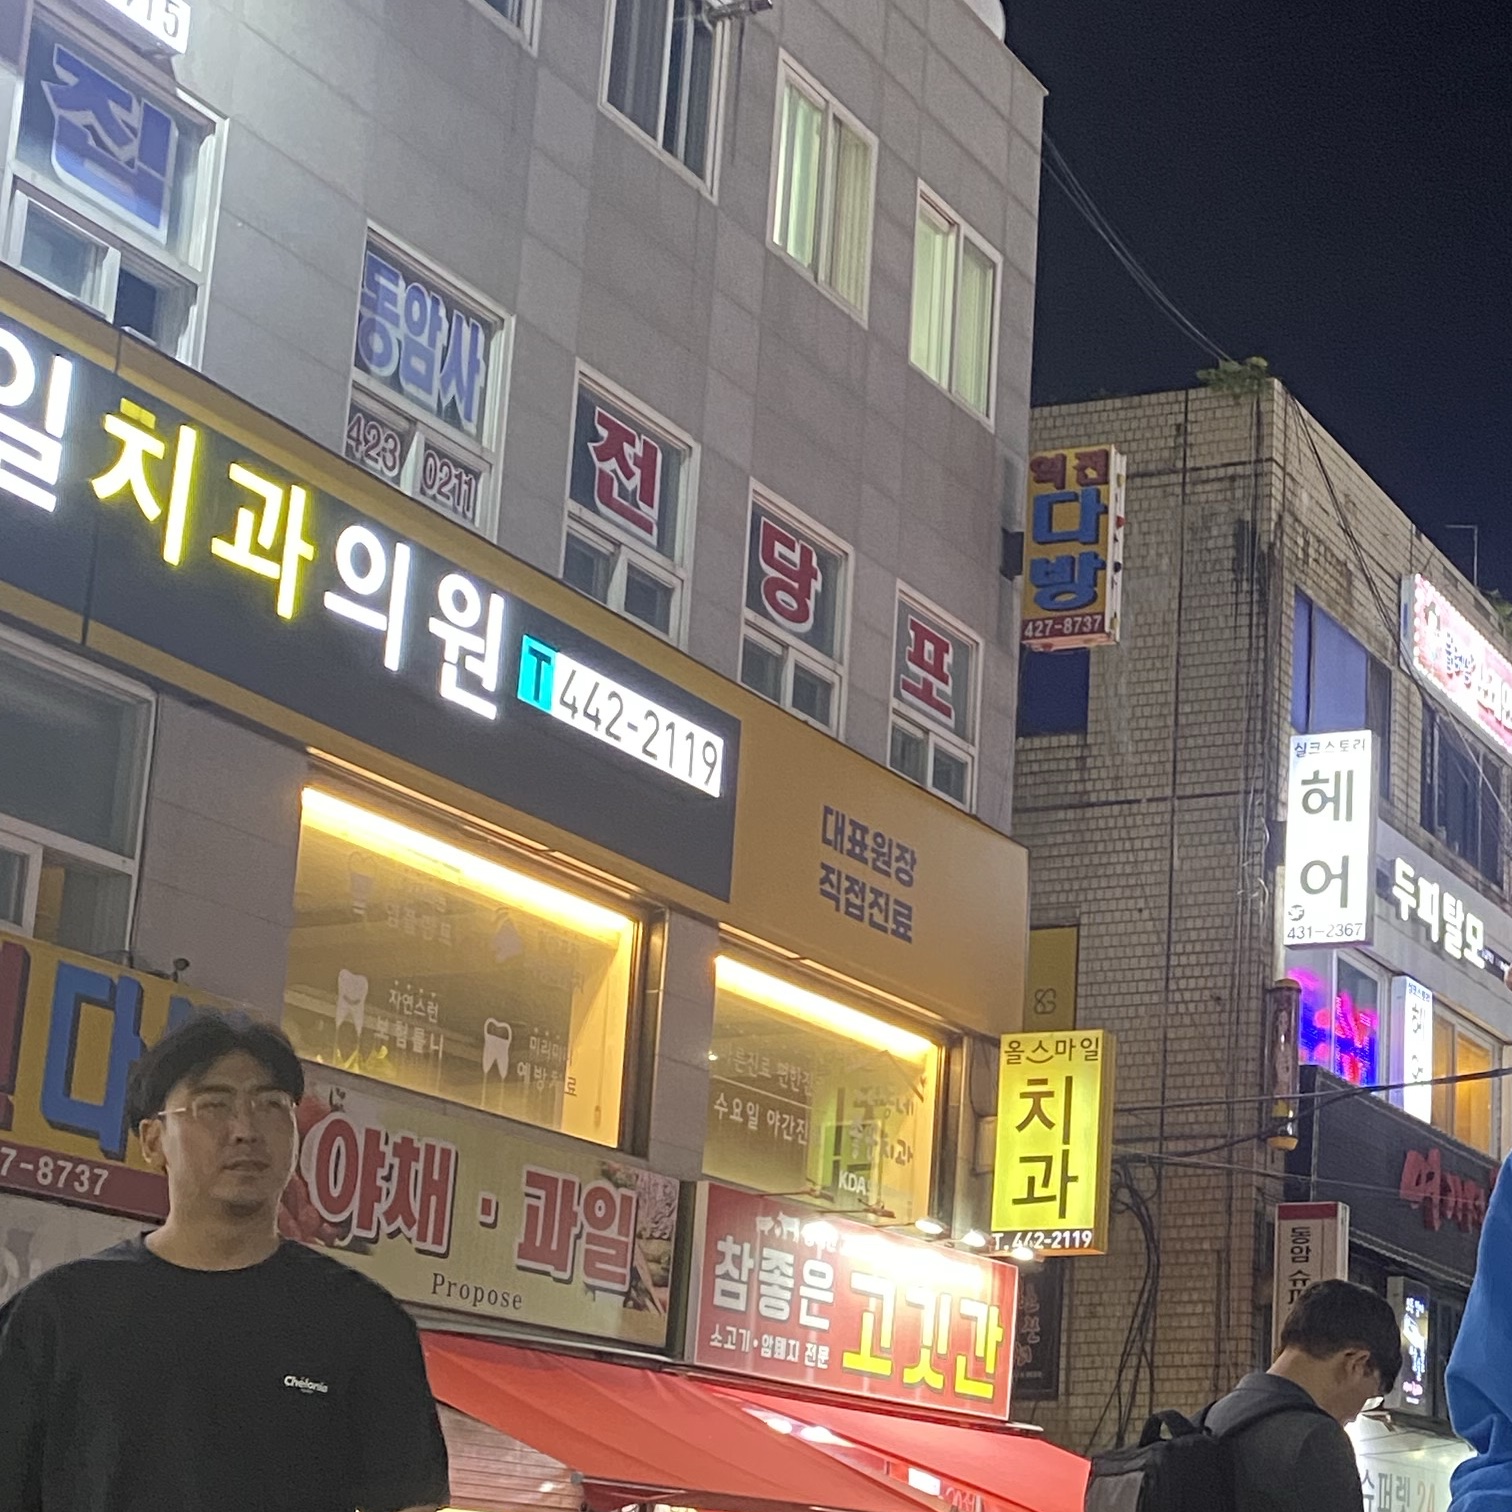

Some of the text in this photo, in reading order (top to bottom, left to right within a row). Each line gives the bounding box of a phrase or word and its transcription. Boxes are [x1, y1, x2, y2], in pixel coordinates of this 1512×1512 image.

[357, 250, 487, 436] 동암사
[346, 411, 478, 518] 423 0211
[1029, 486, 1109, 613] 다방
[1024, 615, 1103, 640] 427-8737
[527, 644, 719, 787] T 442-2119
[1294, 738, 1366, 758] 실크스토리
[821, 804, 917, 888] 대표원장
[1300, 769, 1355, 909] 헤어
[818, 861, 913, 944] 직접진료
[1286, 922, 1364, 941] 431-2367
[1392, 856, 1486, 971] 두피탈모
[1004, 1037, 1100, 1066] 올스마일
[713, 1091, 809, 1146] 수요일 야간진
[1012, 1075, 1079, 1220] 치과
[314, 1115, 637, 1287] 야채 과일
[1290, 1226, 1312, 1263] 동암
[430, 1271, 523, 1310] Propose
[712, 1234, 835, 1332] 참좋은
[841, 1270, 1004, 1400] 고깃간
